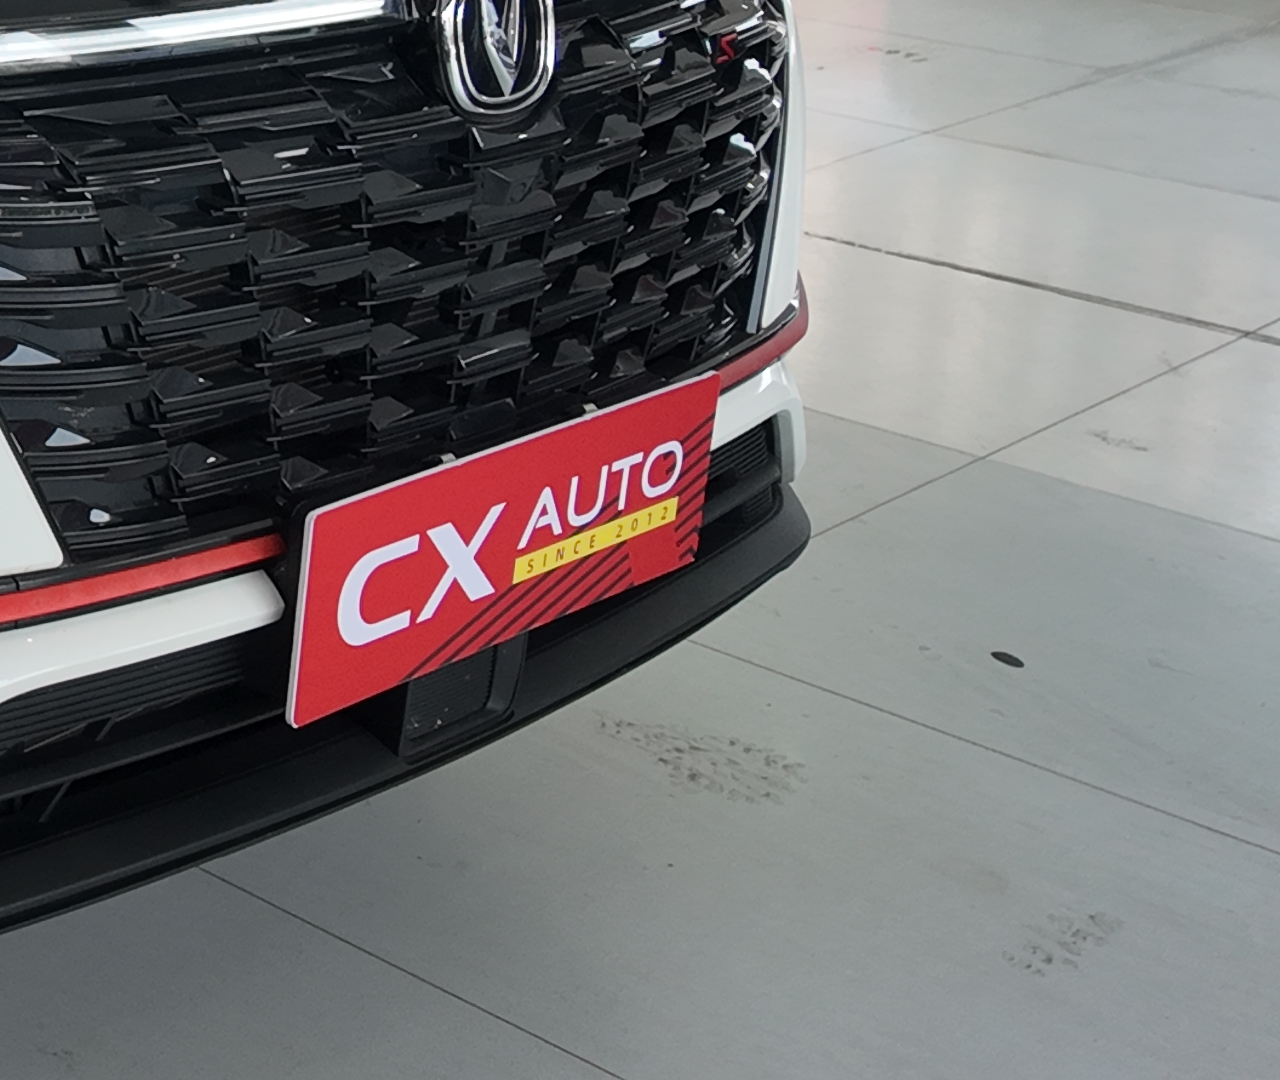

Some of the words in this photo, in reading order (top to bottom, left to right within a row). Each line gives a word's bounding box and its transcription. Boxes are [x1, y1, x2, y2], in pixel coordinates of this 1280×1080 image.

[337, 502, 507, 646] CX
[516, 440, 684, 550] AUTO
[526, 535, 596, 574] SINCE
[615, 505, 669, 538] 2012
